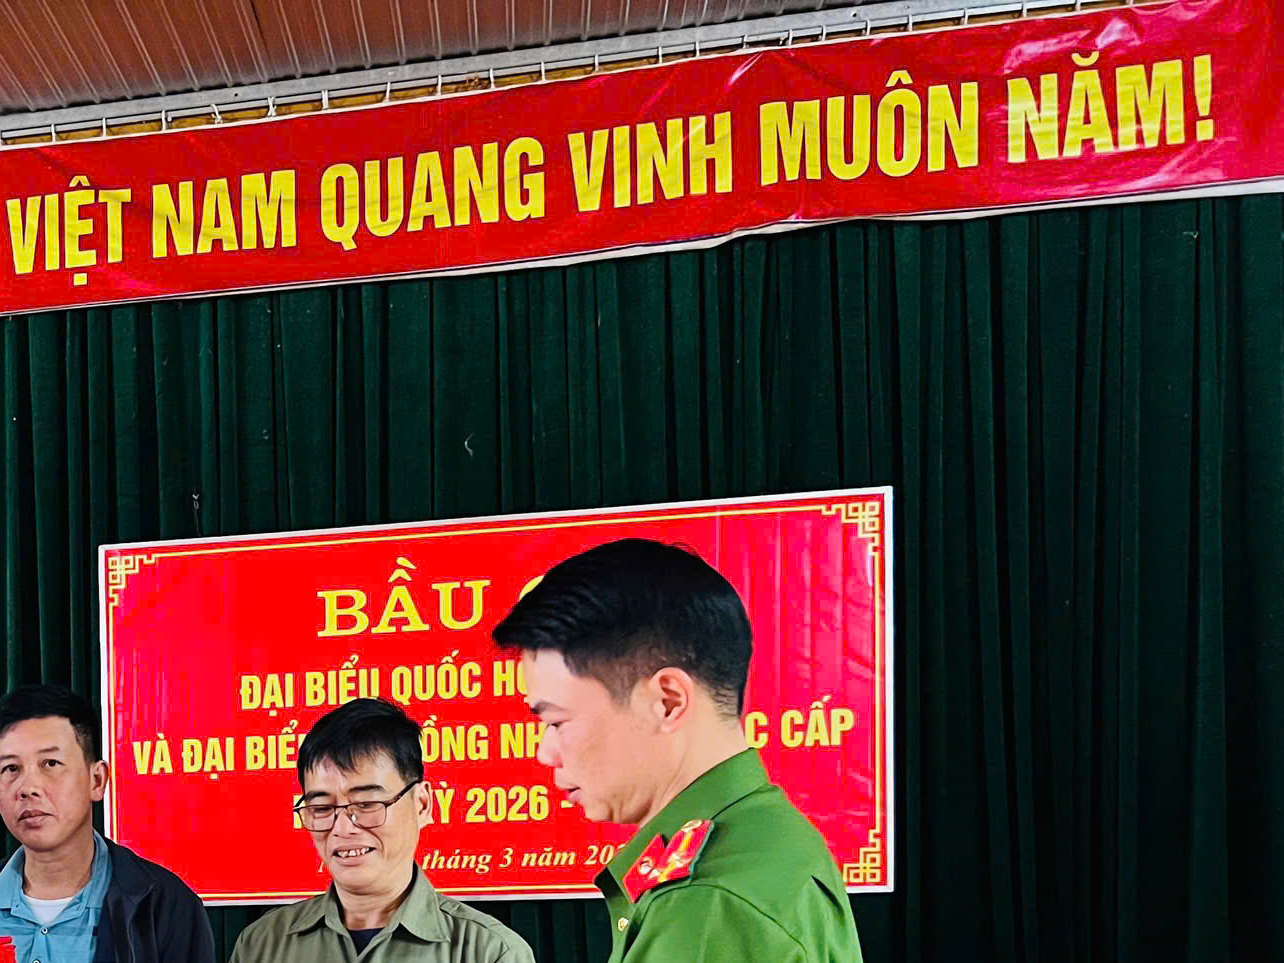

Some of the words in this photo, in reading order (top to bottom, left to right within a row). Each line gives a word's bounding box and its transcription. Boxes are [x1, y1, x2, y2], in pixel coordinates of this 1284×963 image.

[6, 175, 131, 286] VIỆT
[152, 169, 297, 258] NAM
[320, 137, 545, 251] QUANG
[567, 111, 733, 212] VINH
[759, 70, 979, 187] MUÔN
[1007, 51, 1215, 163] NĂM!
[317, 556, 491, 637] BẦU
[240, 673, 293, 716] ĐẠI
[305, 654, 380, 707] BIỂU
[391, 650, 482, 706] QUỐC
[132, 733, 173, 775] VÀ
[182, 737, 235, 779] ĐẠI
[245, 720, 306, 770] BIỂ
[780, 694, 855, 747] CẤP
[466, 785, 549, 823] 2026
[421, 849, 493, 874] tháng
[499, 848, 514, 868] 3
[521, 847, 576, 867] năm
